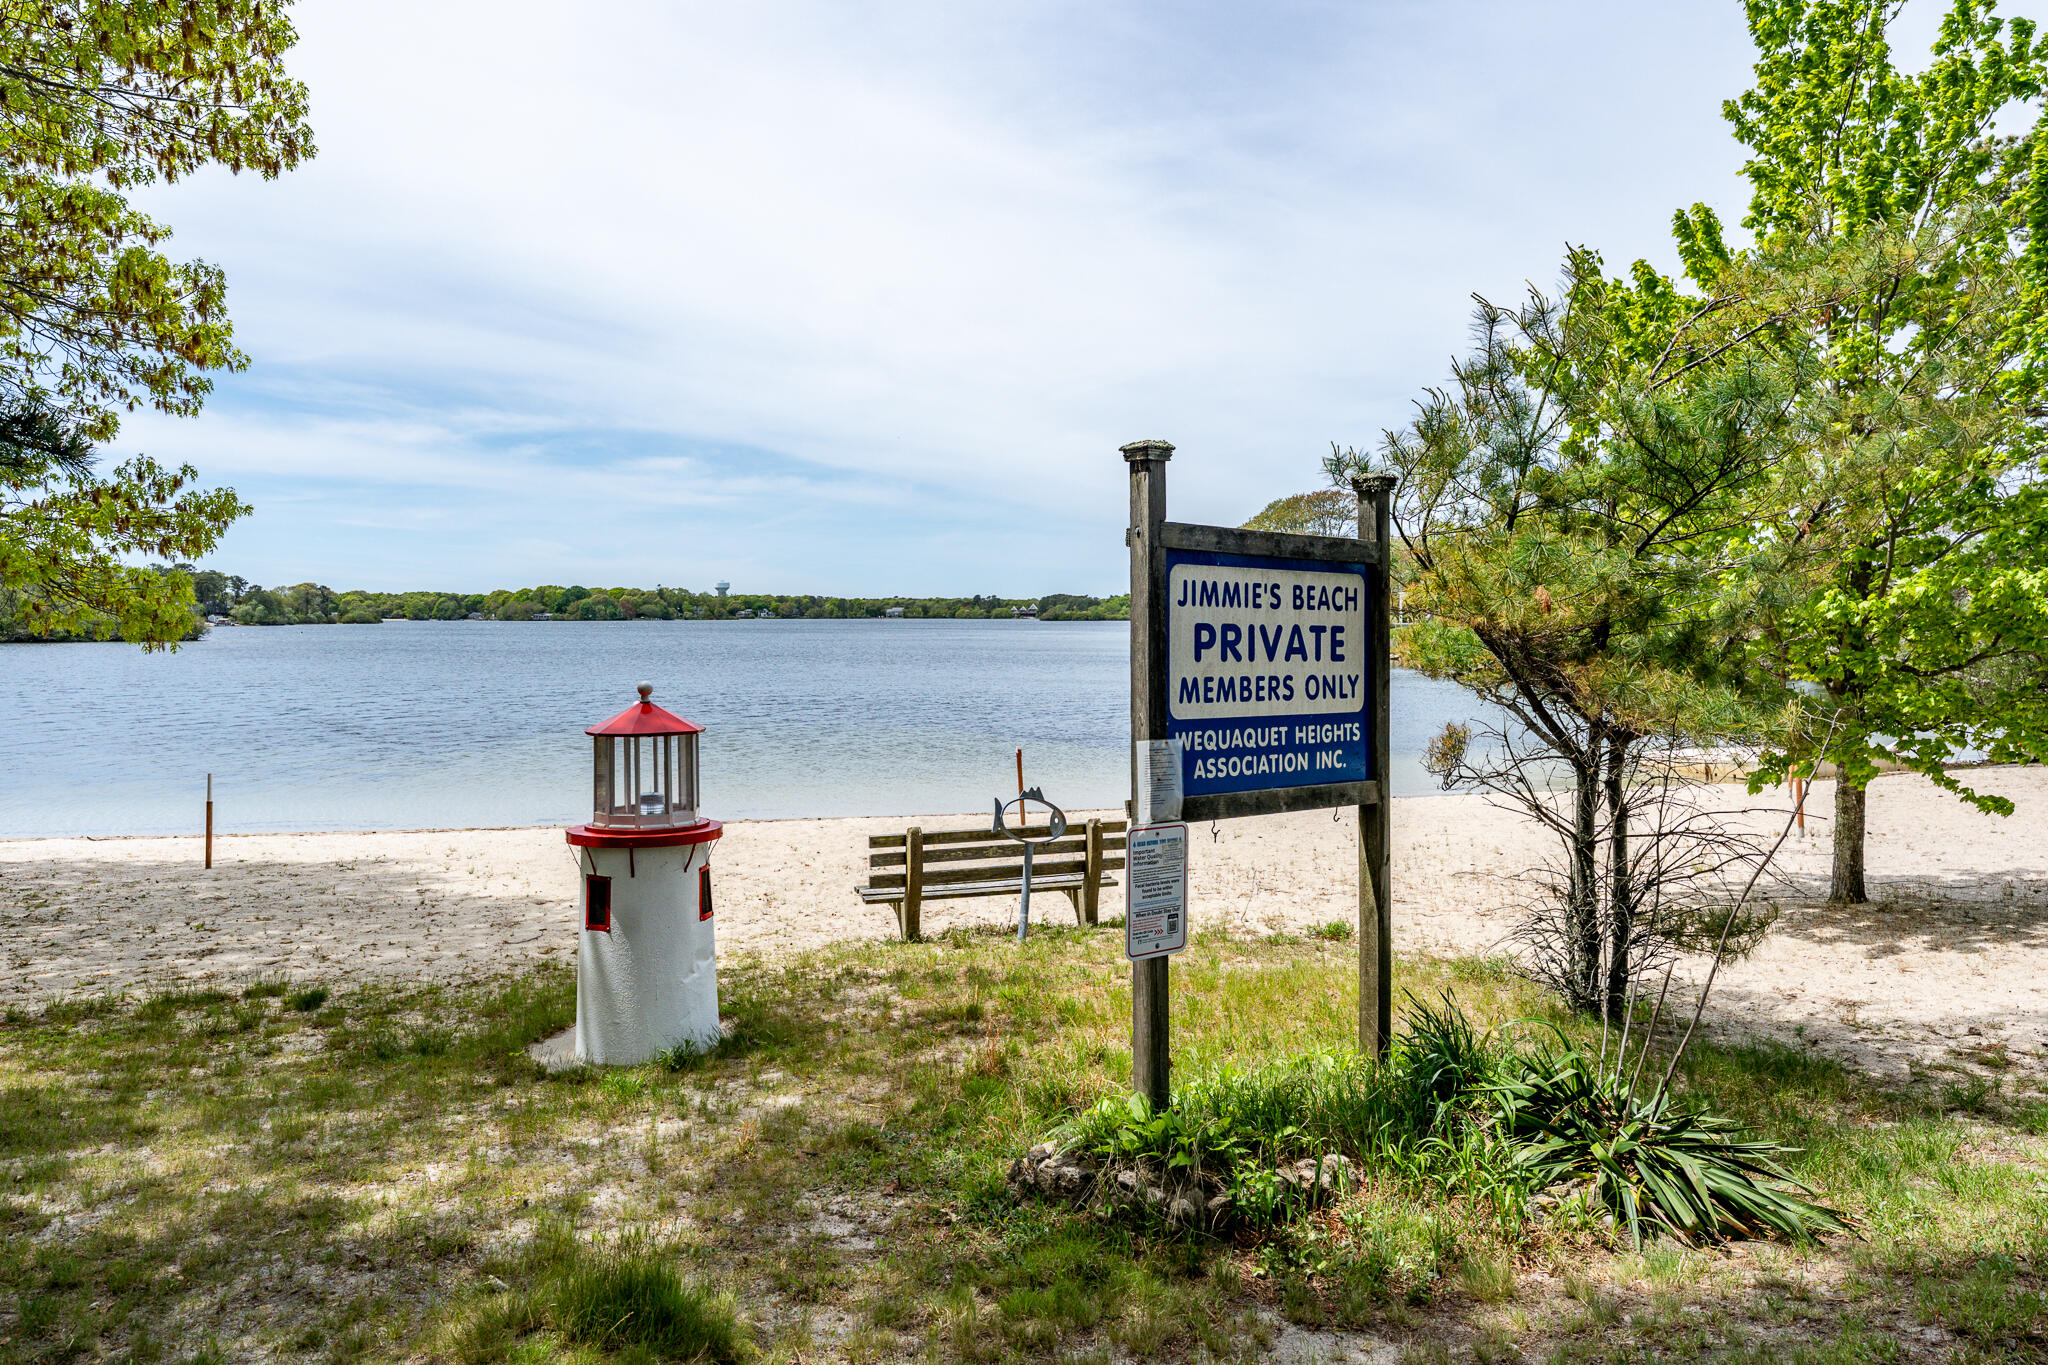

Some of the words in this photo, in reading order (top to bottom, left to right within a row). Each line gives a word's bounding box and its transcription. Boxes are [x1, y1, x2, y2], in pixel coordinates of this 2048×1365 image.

[1177, 579, 1282, 610] JIMMIE'S
[1293, 584, 1358, 612] BEACH
[1194, 622, 1345, 663] PRIVATE
[1178, 675, 1294, 704] MEMBERS
[1305, 674, 1359, 700] ONLY
[1176, 726, 1288, 751] WEQUAQUET
[1295, 723, 1360, 744] HEIGHTS
[1194, 752, 1308, 779] ASSOCIATION
[1316, 750, 1347, 770] INC.
